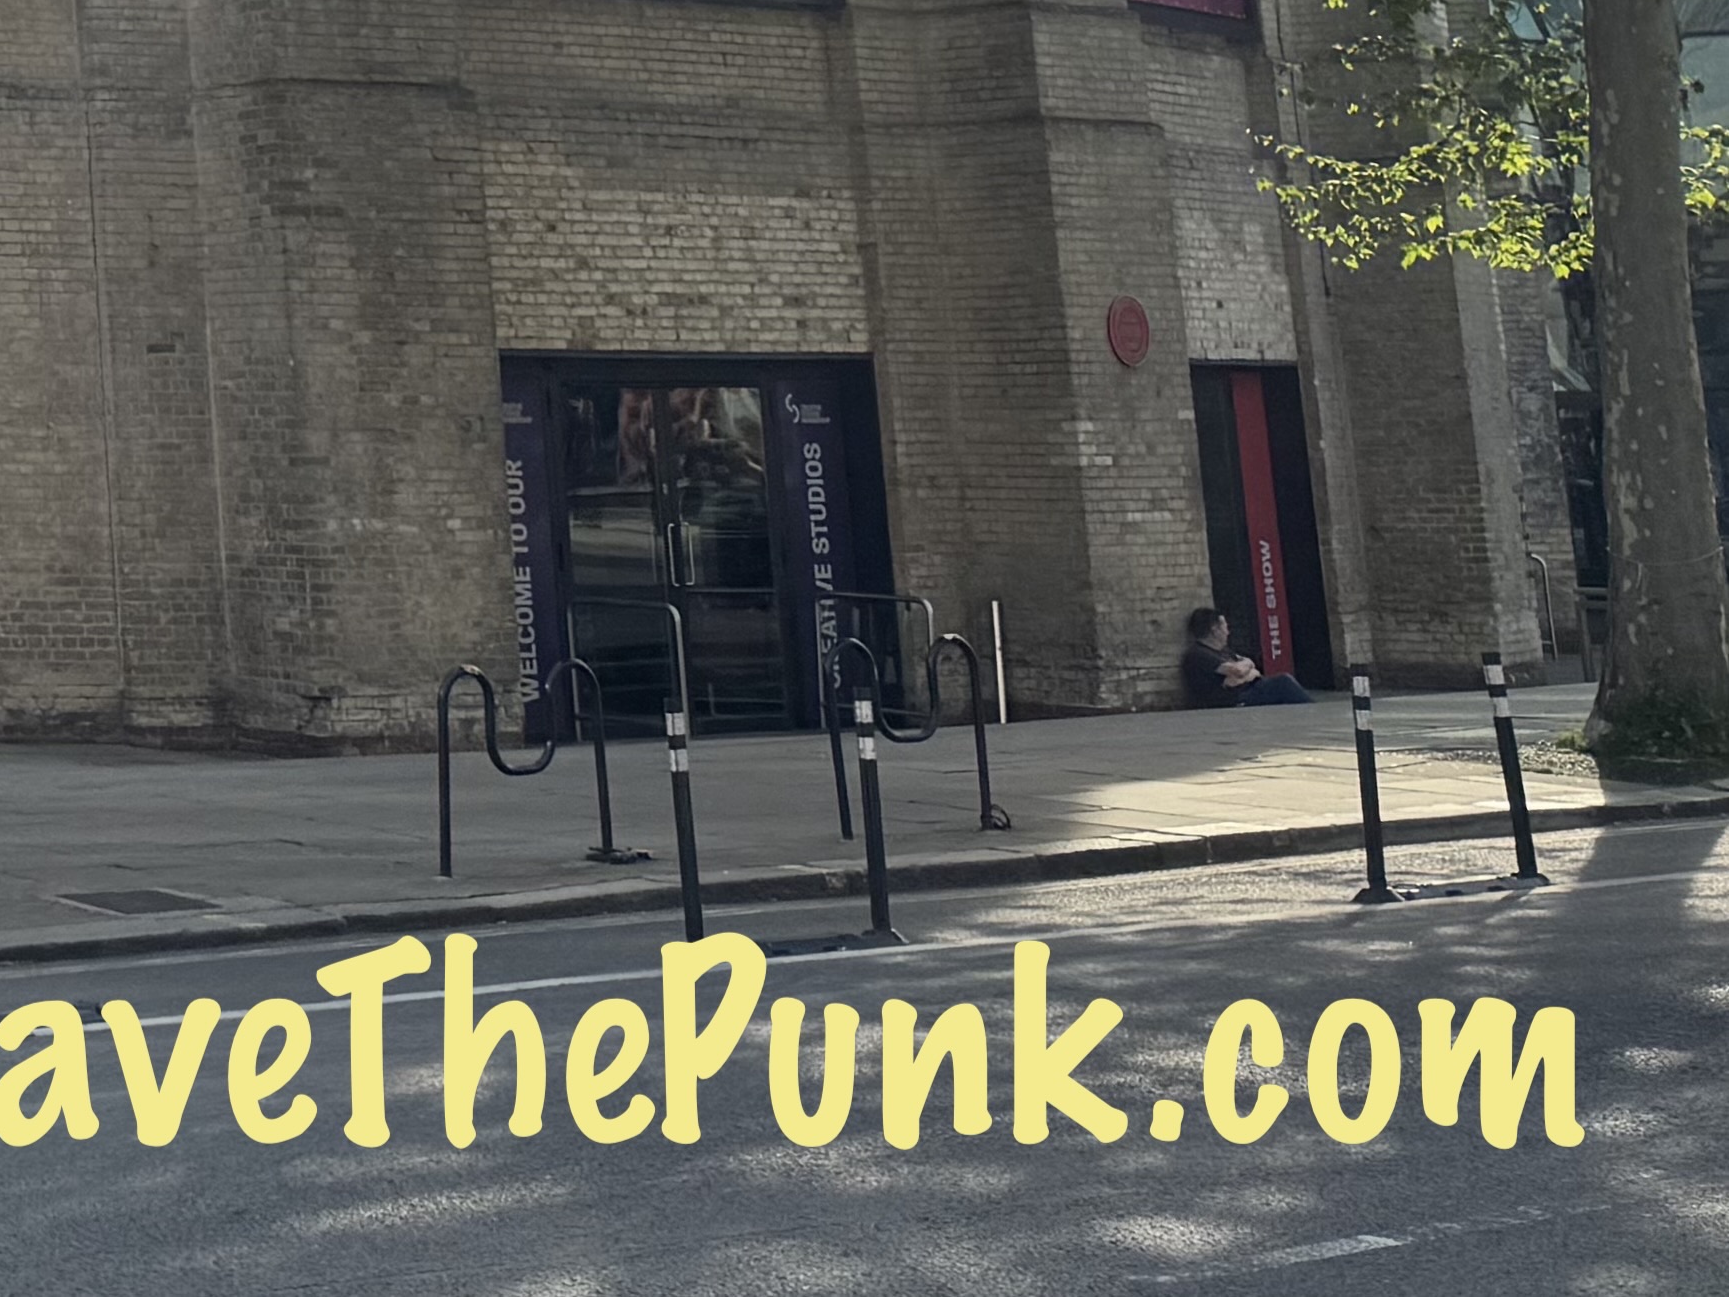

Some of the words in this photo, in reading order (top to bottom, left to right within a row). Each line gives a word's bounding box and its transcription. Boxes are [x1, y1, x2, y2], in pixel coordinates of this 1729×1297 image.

[505, 459, 526, 515] OUR
[803, 442, 831, 554] STUDIOS
[511, 520, 529, 558] TO
[1259, 540, 1277, 609] SHOW
[514, 566, 540, 703] WELCOME
[1268, 616, 1281, 660] THE
